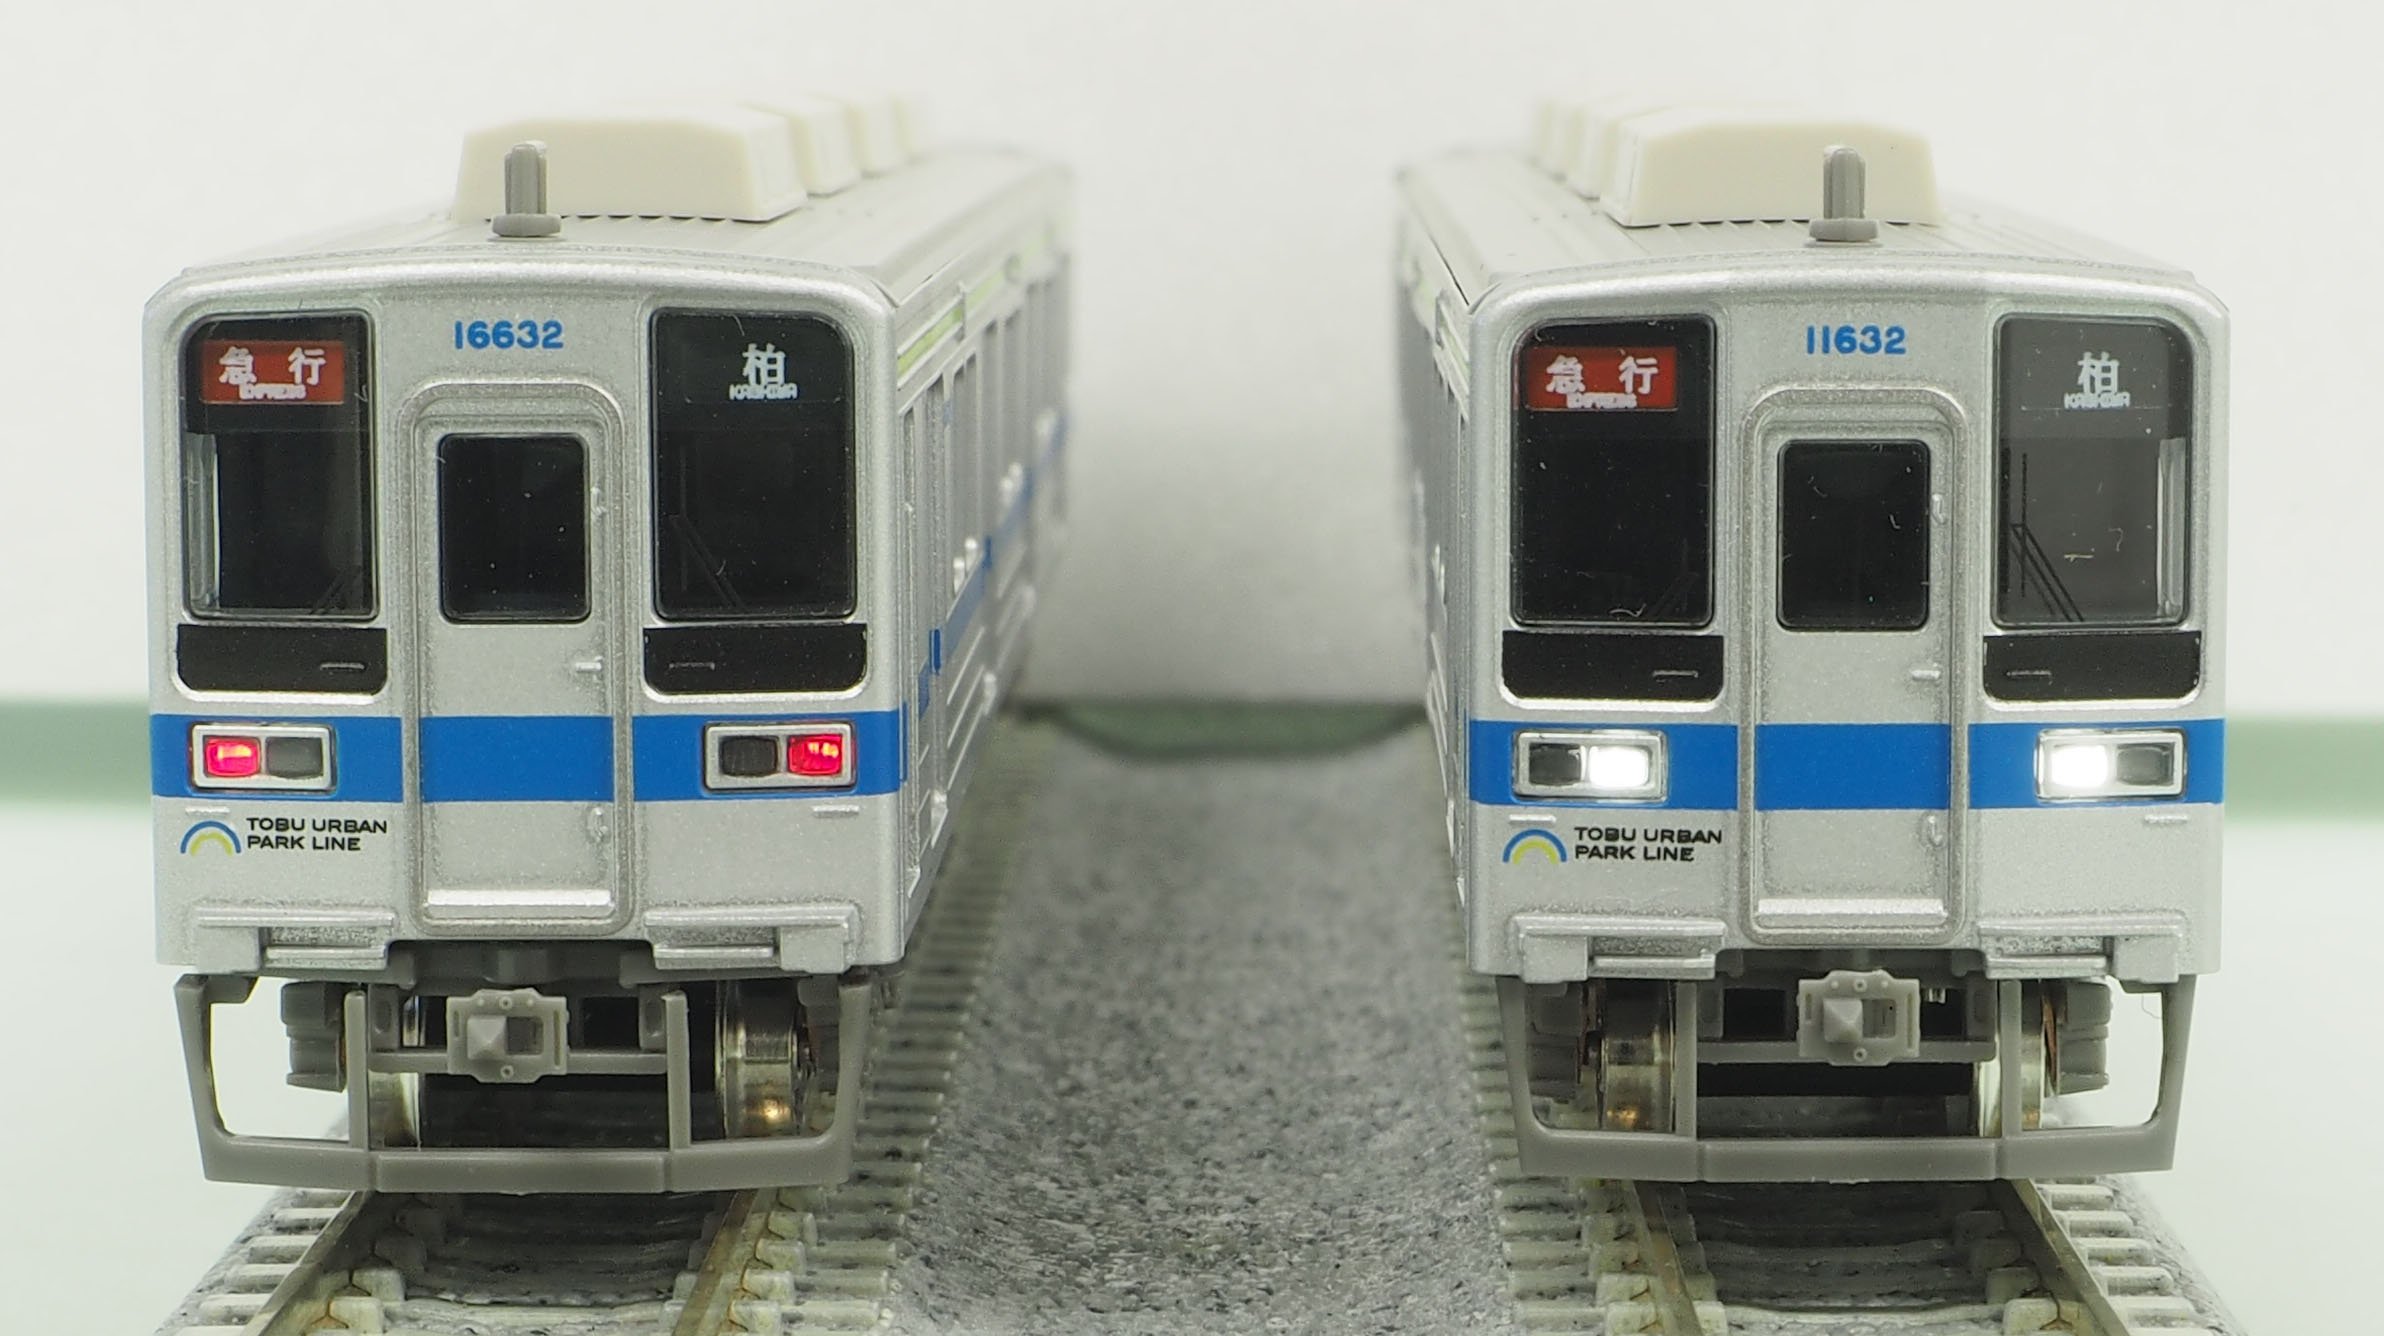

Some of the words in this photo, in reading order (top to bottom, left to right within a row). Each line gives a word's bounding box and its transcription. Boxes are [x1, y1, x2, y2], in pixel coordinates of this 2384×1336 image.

[455, 320, 564, 349] 16632
[1807, 325, 1906, 354] 11632
[742, 343, 786, 385] 柏
[2077, 352, 2119, 394] 柏
[246, 818, 305, 831] TOBU
[312, 819, 387, 833] URBAN
[1574, 827, 1636, 841] TOBU
[1644, 829, 1722, 843] URBAN
[247, 836, 305, 849] PARK
[313, 837, 361, 850] LINE
[1575, 845, 1635, 859] PARK
[1644, 847, 1694, 861] LINE
